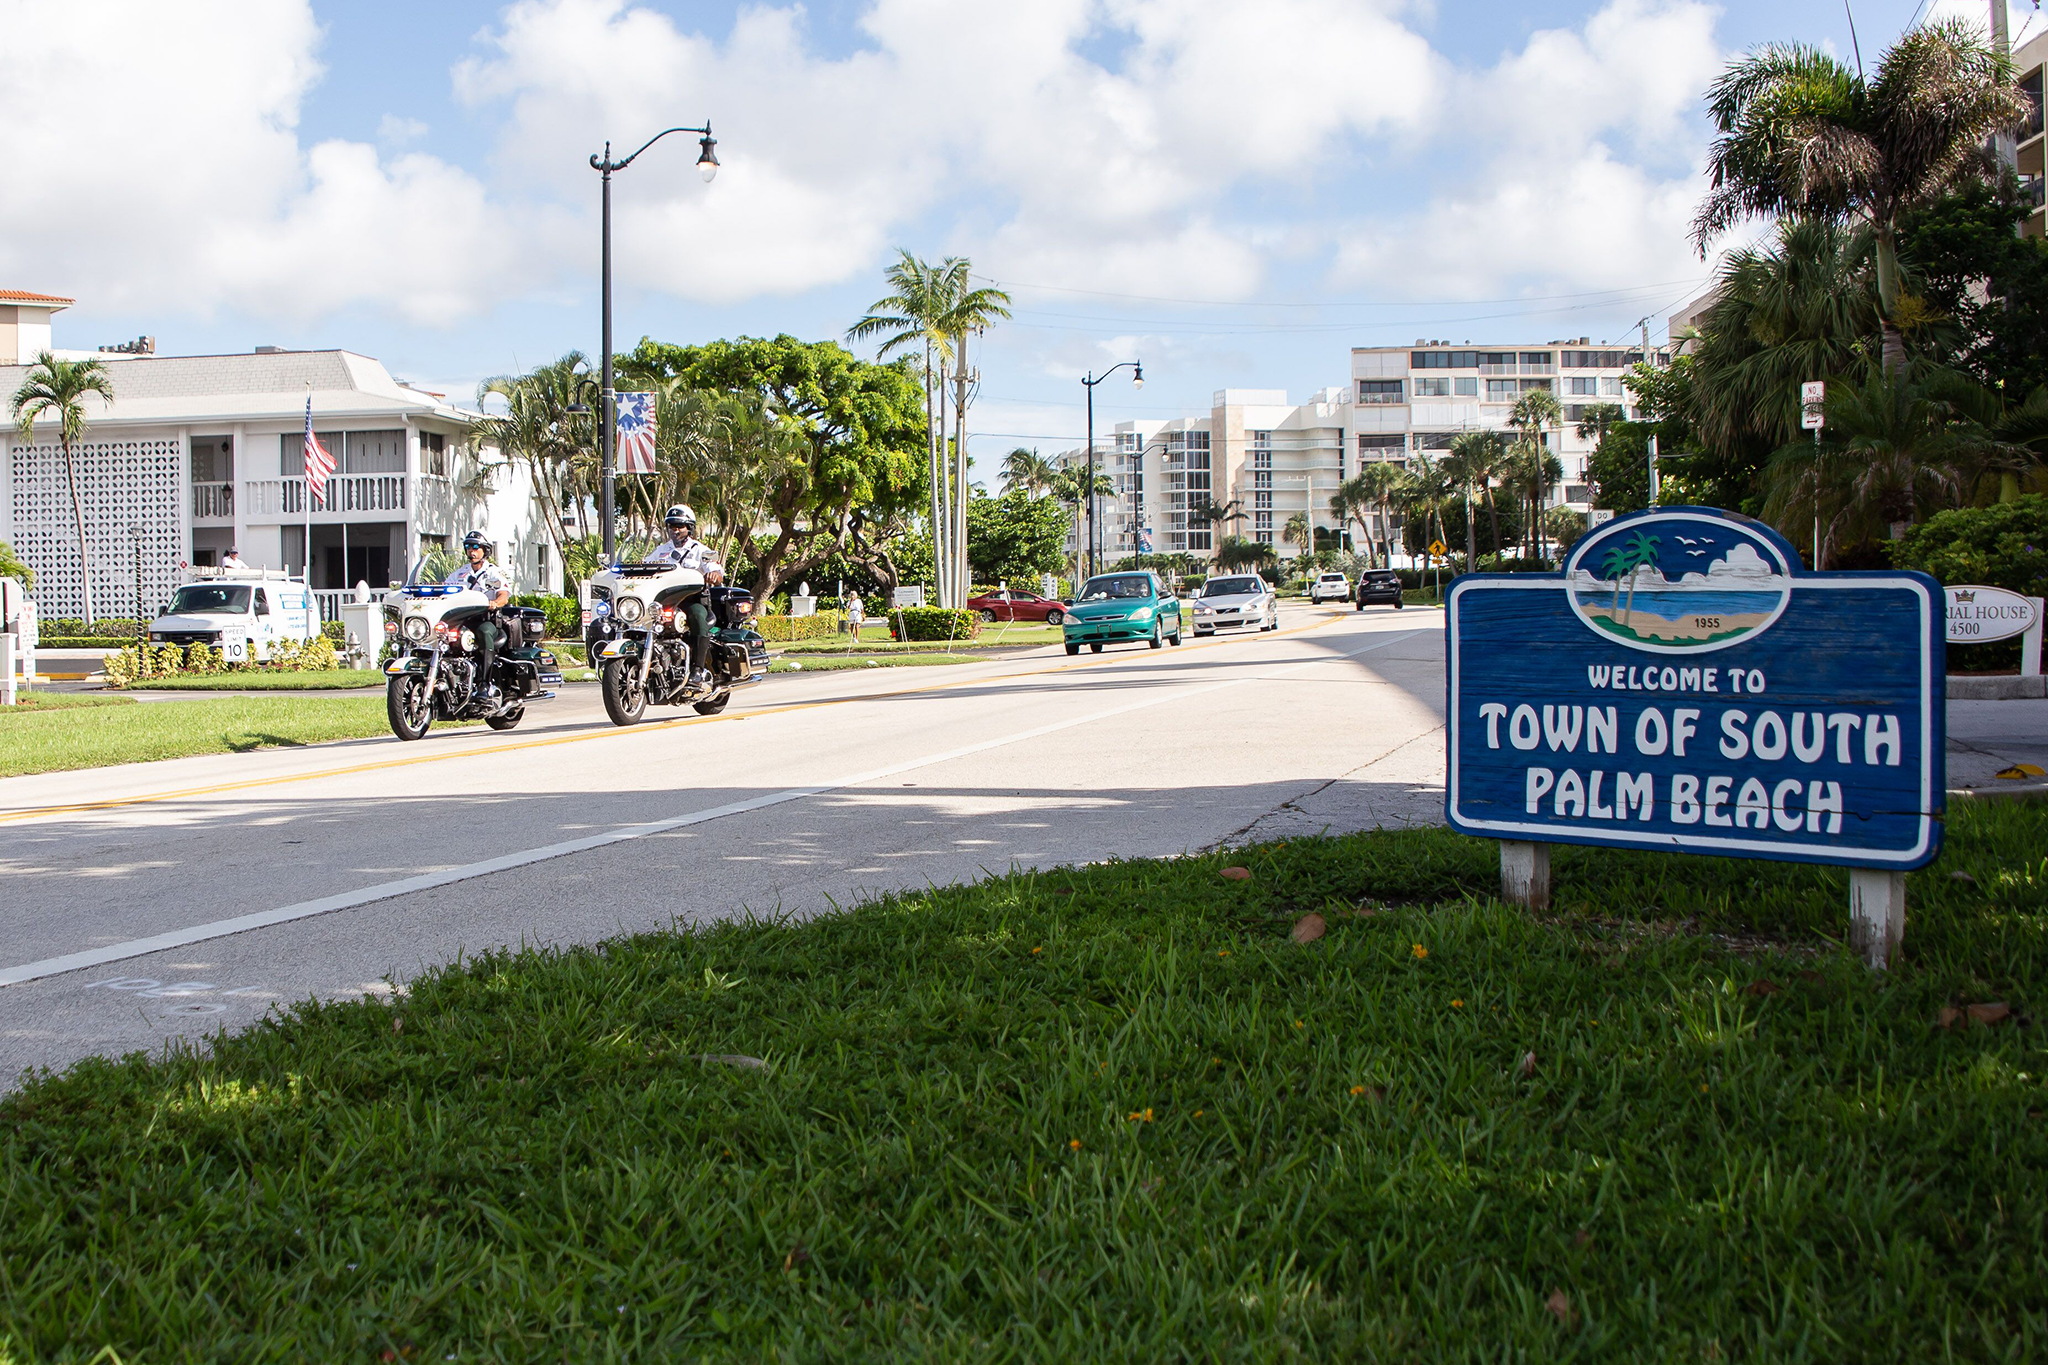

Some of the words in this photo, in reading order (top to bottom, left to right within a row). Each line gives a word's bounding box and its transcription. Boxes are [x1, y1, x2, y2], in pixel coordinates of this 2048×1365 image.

[1808, 386, 1817, 395] NO
[1597, 512, 1608, 520] DO
[1975, 605, 2028, 620] HOUSE
[1694, 617, 1720, 629] 1955
[1950, 621, 1981, 636] 4500
[228, 644, 242, 657] 10
[1588, 665, 1720, 692] WELCOME
[1728, 668, 1766, 693] TO
[1479, 702, 1618, 755] TOWN
[1635, 707, 1701, 757] OF
[1719, 709, 1901, 767] SOUTH
[1526, 767, 1654, 822] PALM
[1671, 774, 1844, 834] BEACH
